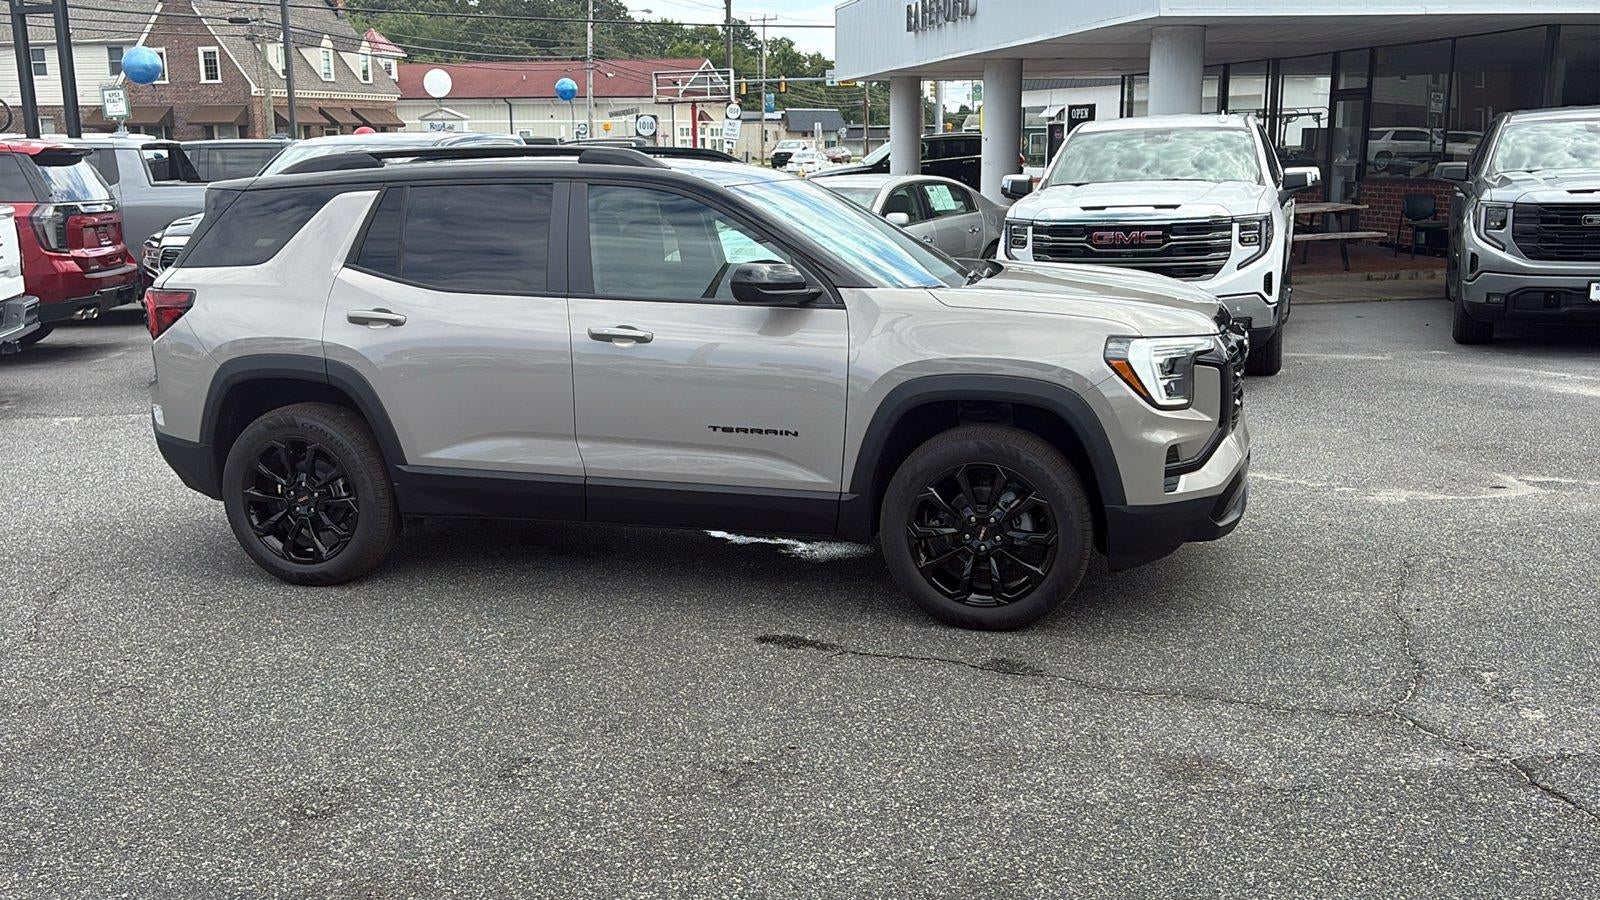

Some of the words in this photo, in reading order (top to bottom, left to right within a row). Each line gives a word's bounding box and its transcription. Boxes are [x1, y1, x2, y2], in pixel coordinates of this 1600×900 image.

[1071, 108, 1089, 119] OPEN
[639, 121, 654, 130] 1010
[1092, 231, 1163, 244] GMC
[708, 425, 799, 437] TERRAIN
